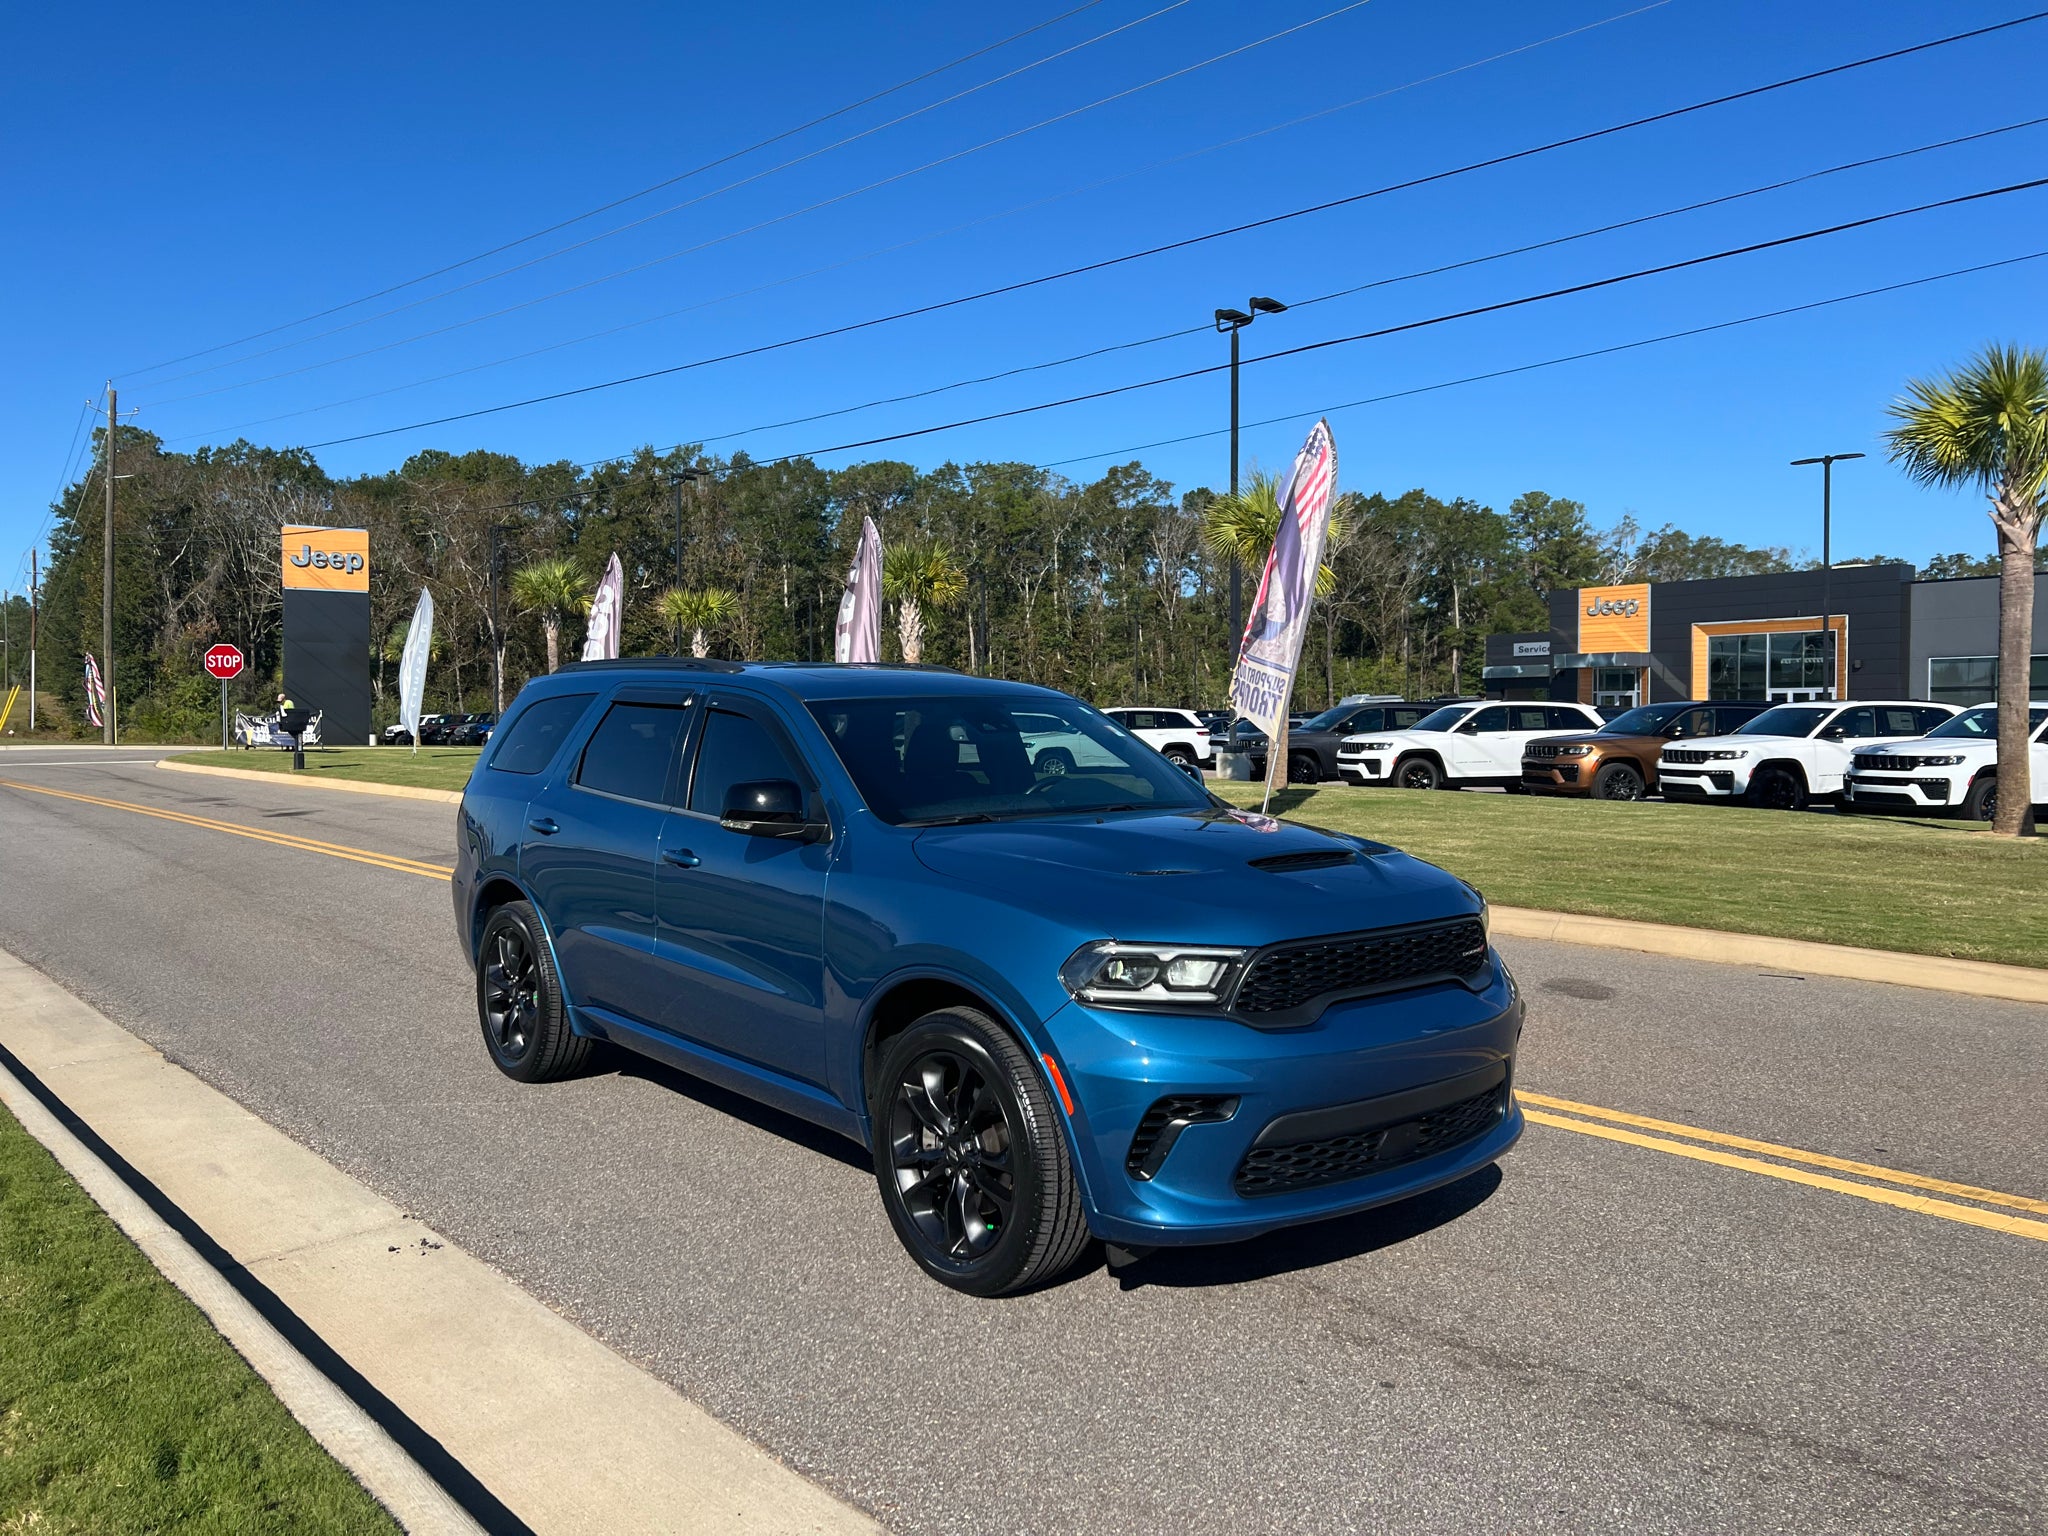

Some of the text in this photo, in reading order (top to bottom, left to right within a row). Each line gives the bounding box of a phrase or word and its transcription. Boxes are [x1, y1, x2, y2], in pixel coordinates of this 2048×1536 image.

[290, 544, 364, 574] Jeep
[1586, 596, 1640, 618] Jeep
[207, 655, 240, 668] STOP
